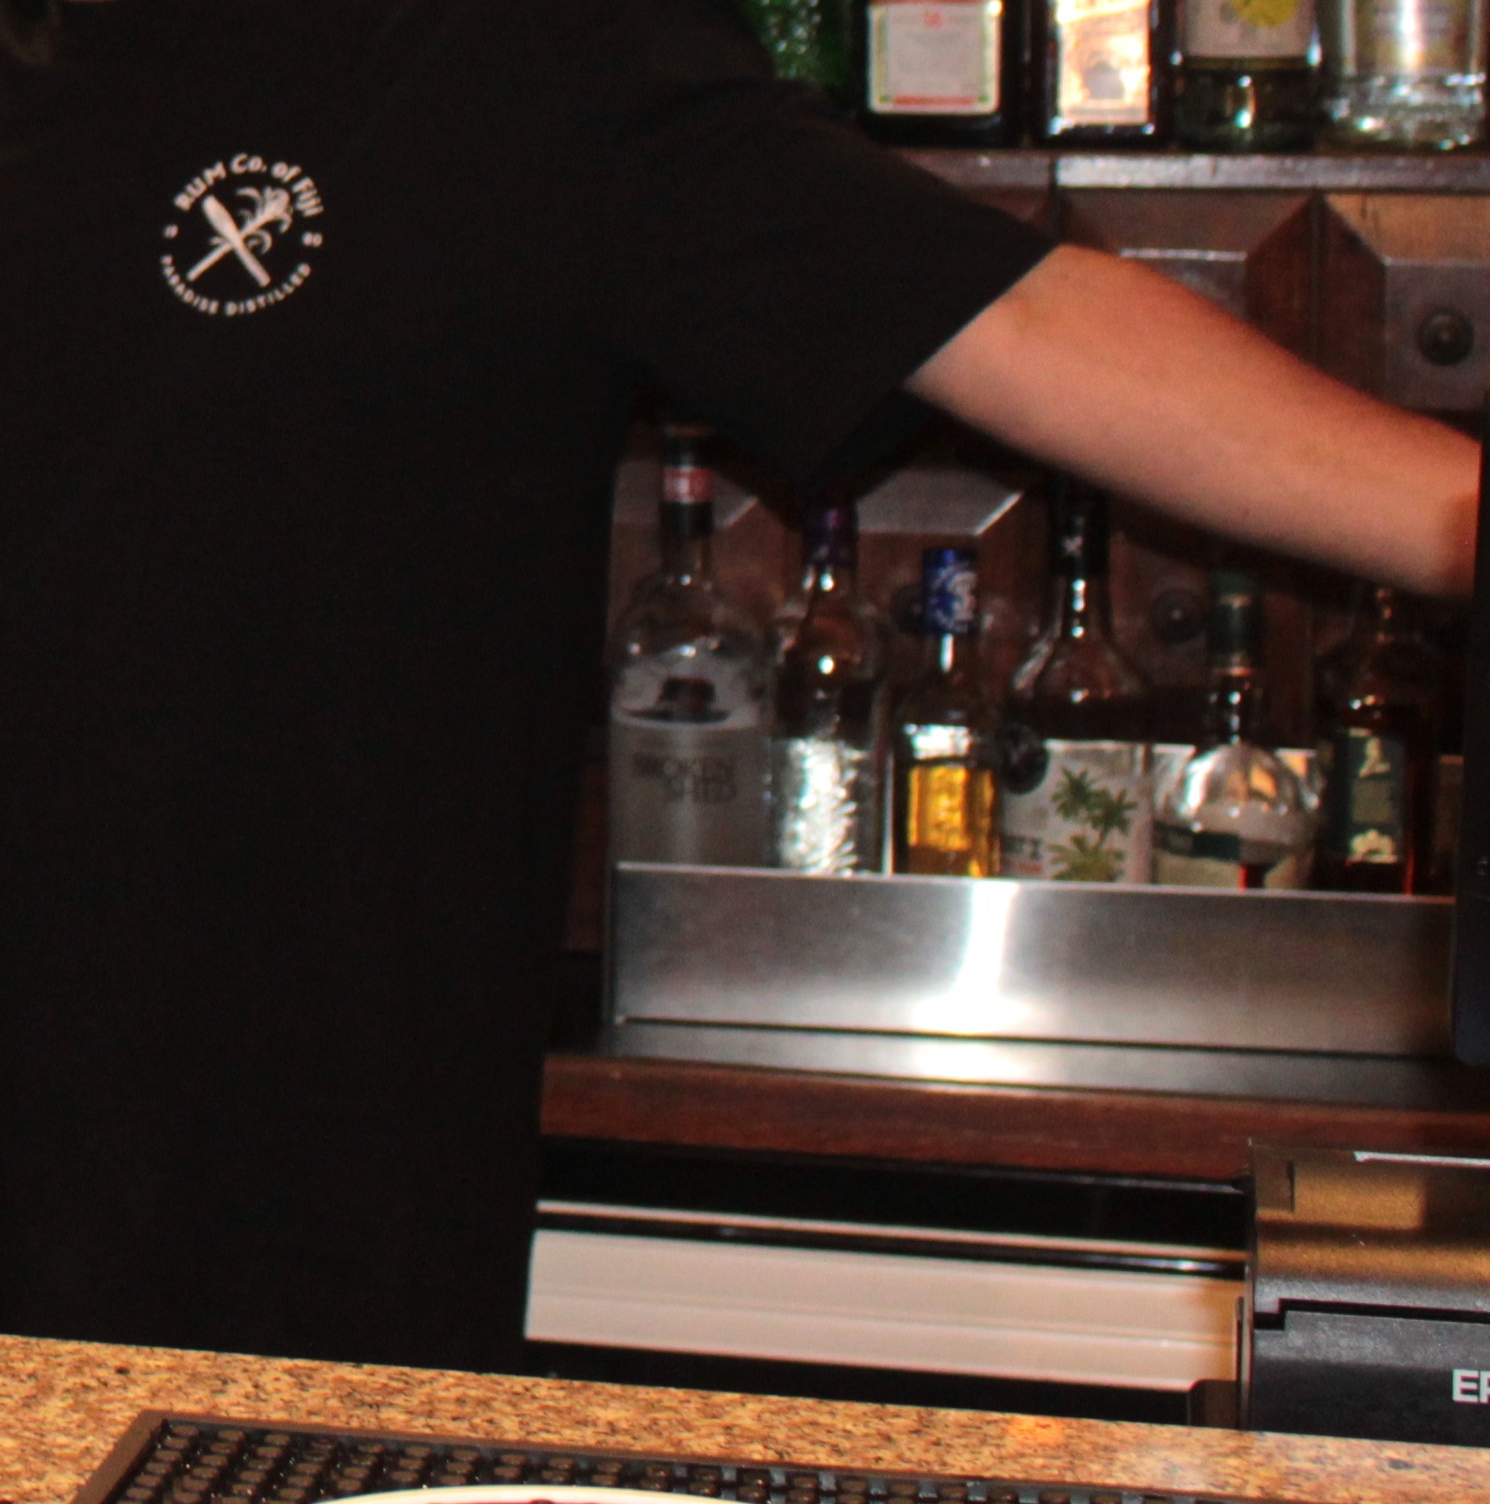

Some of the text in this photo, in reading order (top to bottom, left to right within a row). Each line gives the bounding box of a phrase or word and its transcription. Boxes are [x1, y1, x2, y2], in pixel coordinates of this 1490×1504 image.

[173, 161, 227, 212] RUM
[160, 254, 311, 317] PARADISE DISTILLED
